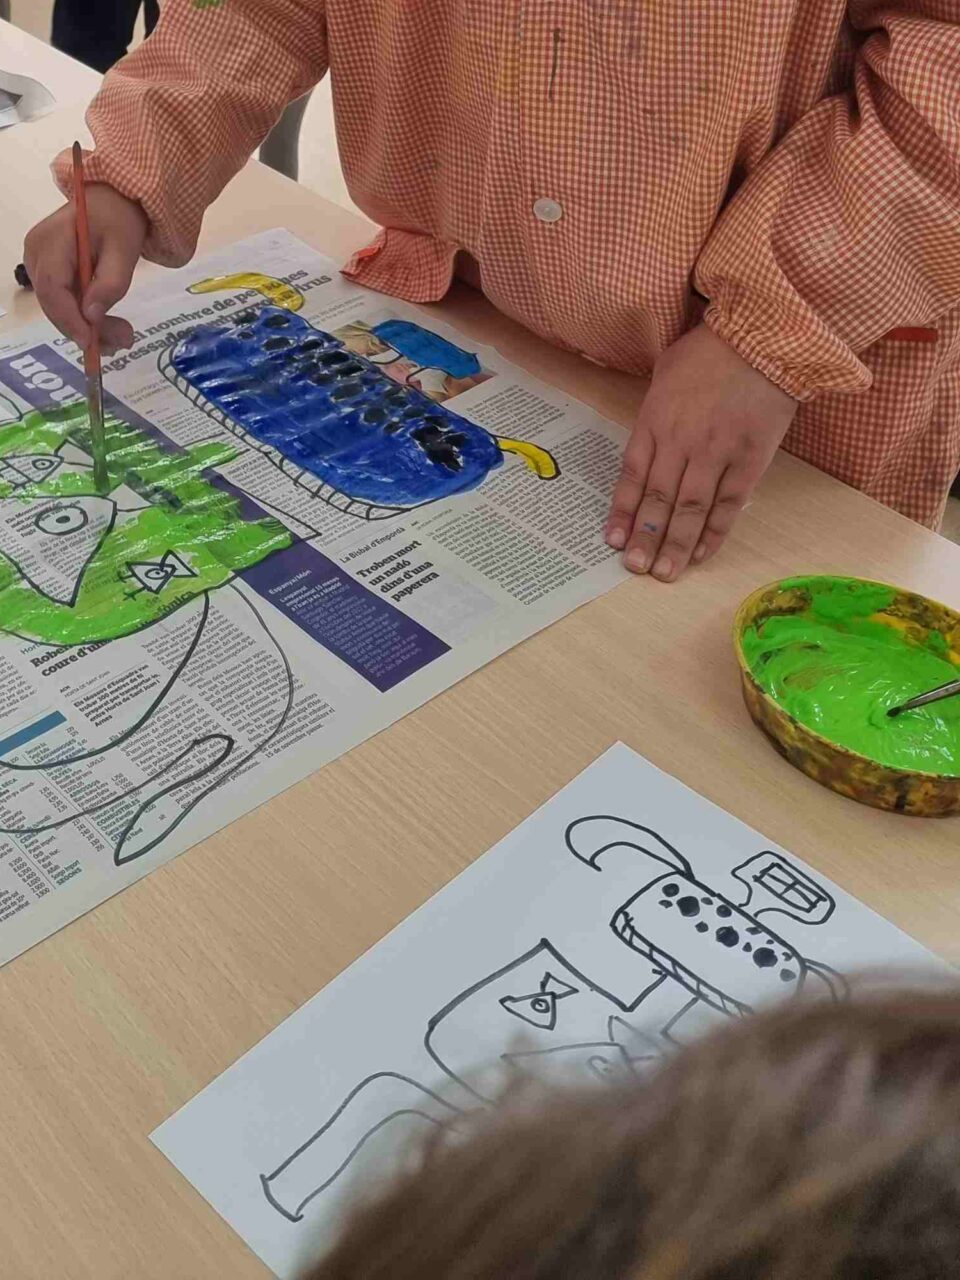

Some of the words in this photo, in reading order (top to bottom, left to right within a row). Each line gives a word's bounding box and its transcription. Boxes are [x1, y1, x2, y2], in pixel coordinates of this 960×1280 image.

[142, 303, 214, 338] nombre
[209, 295, 237, 312] de
[339, 554, 351, 563] La
[348, 543, 372, 558] Bisbal
[368, 525, 406, 548] d'Empordà
[355, 552, 399, 579] Troben
[393, 538, 423, 558] mort
[368, 574, 386, 586] un
[381, 557, 412, 578] nadó
[377, 575, 406, 593] dins
[401, 559, 434, 580] d'una
[388, 570, 441, 603] paperera
[39, 653, 79, 677] coure
[73, 699, 84, 707] Els
[82, 686, 107, 701] Mossos
[105, 669, 139, 689] d'Esquadra
[137, 663, 149, 671] van
[78, 699, 98, 712] trobar
[108, 681, 130, 694] metres
[83, 700, 111, 717] preparat
[87, 710, 106, 722] entre
[104, 700, 122, 712] Horta
[93, 714, 113, 727] Arnes
[279, 731, 307, 750] novembre
